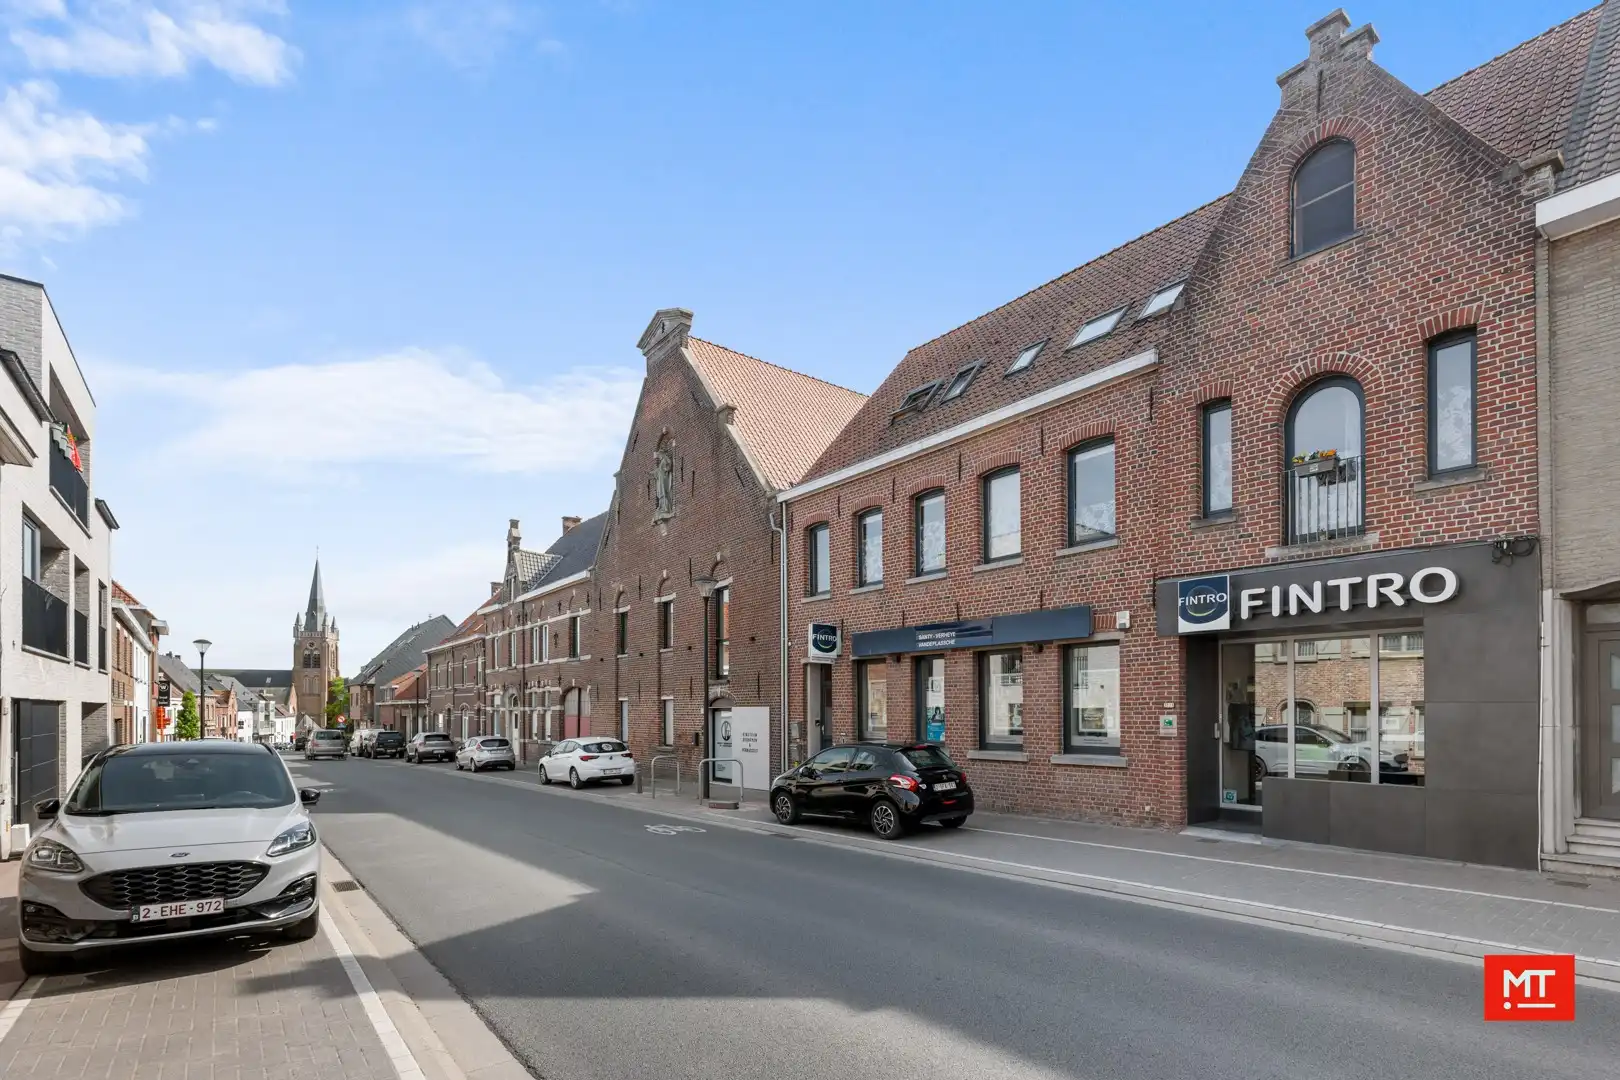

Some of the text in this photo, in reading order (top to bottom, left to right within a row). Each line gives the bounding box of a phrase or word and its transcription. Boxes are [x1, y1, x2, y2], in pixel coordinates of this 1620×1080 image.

[1178, 592, 1228, 607] FINTRO
[1240, 566, 1459, 621] FINTRO
[812, 633, 837, 642] FINTRO
[142, 900, 222, 919] 2-EHE-972
